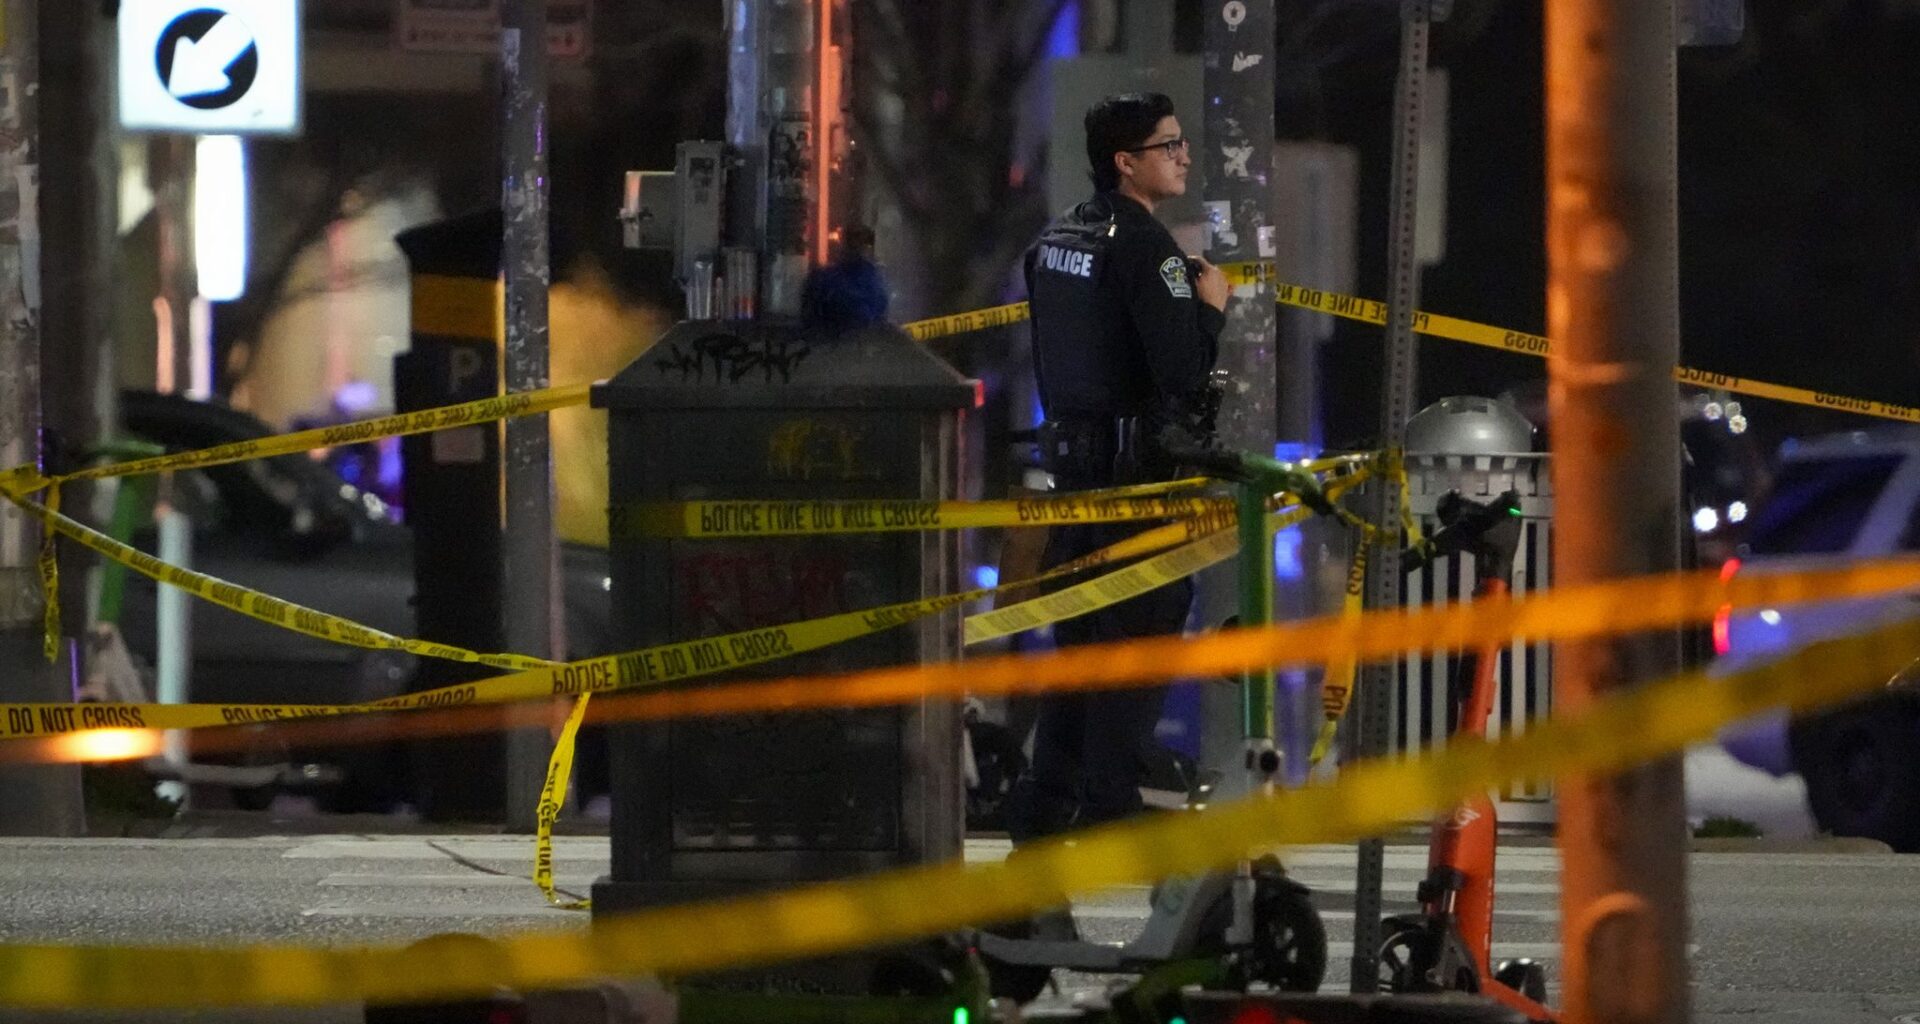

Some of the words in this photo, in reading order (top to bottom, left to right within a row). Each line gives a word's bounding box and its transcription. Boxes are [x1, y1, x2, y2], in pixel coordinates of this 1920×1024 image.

[1039, 245, 1094, 277] POLICE
[8, 707, 34, 735] DO
[40, 706, 76, 733] NOT
[82, 706, 146, 729] CROSS
